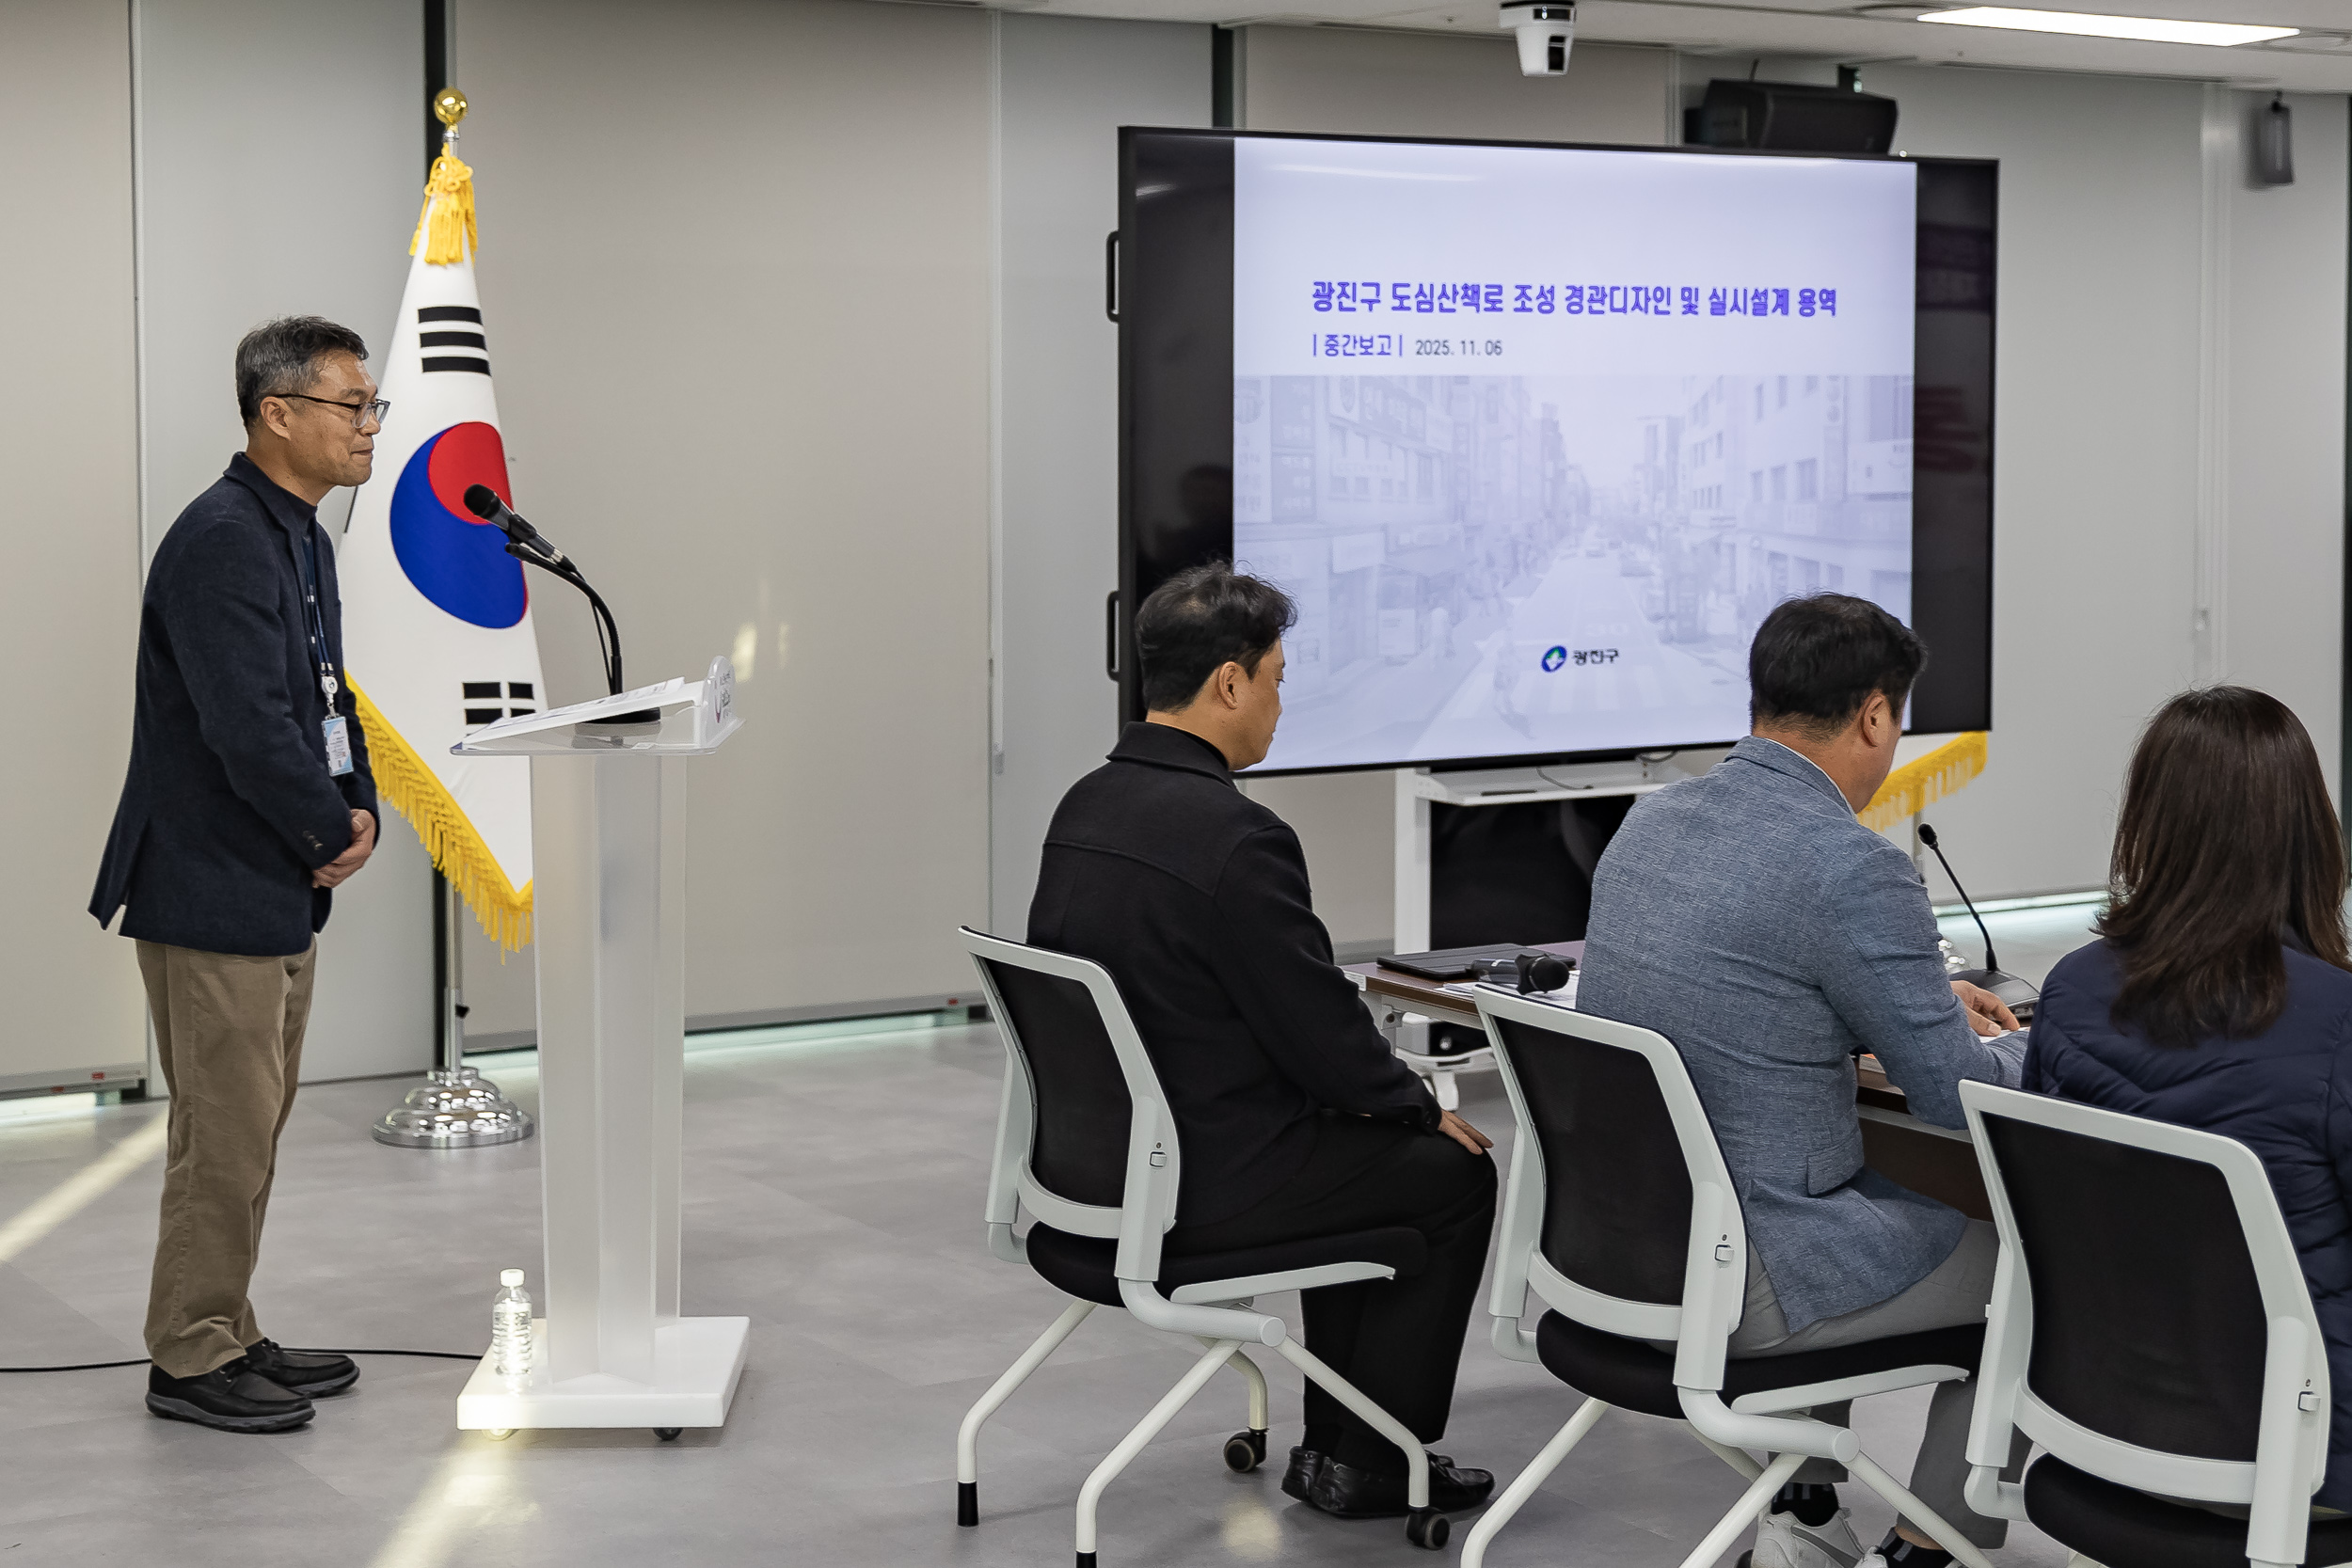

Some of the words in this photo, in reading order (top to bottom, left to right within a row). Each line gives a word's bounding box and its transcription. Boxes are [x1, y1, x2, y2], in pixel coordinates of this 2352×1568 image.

[1312, 280, 1381, 312] 광진구
[1391, 282, 1503, 313] 도심산책로
[1512, 284, 1555, 314] 조성
[1565, 284, 1671, 315] 경관디자인
[1680, 286, 1699, 315] 및
[1708, 287, 1789, 317] 실시설계
[1798, 288, 1836, 317] 용역
[1324, 333, 1391, 356] 중간보고
[1415, 339, 1454, 356] 2025.
[1460, 340, 1481, 356] 11.
[1485, 339, 1502, 356] 06
